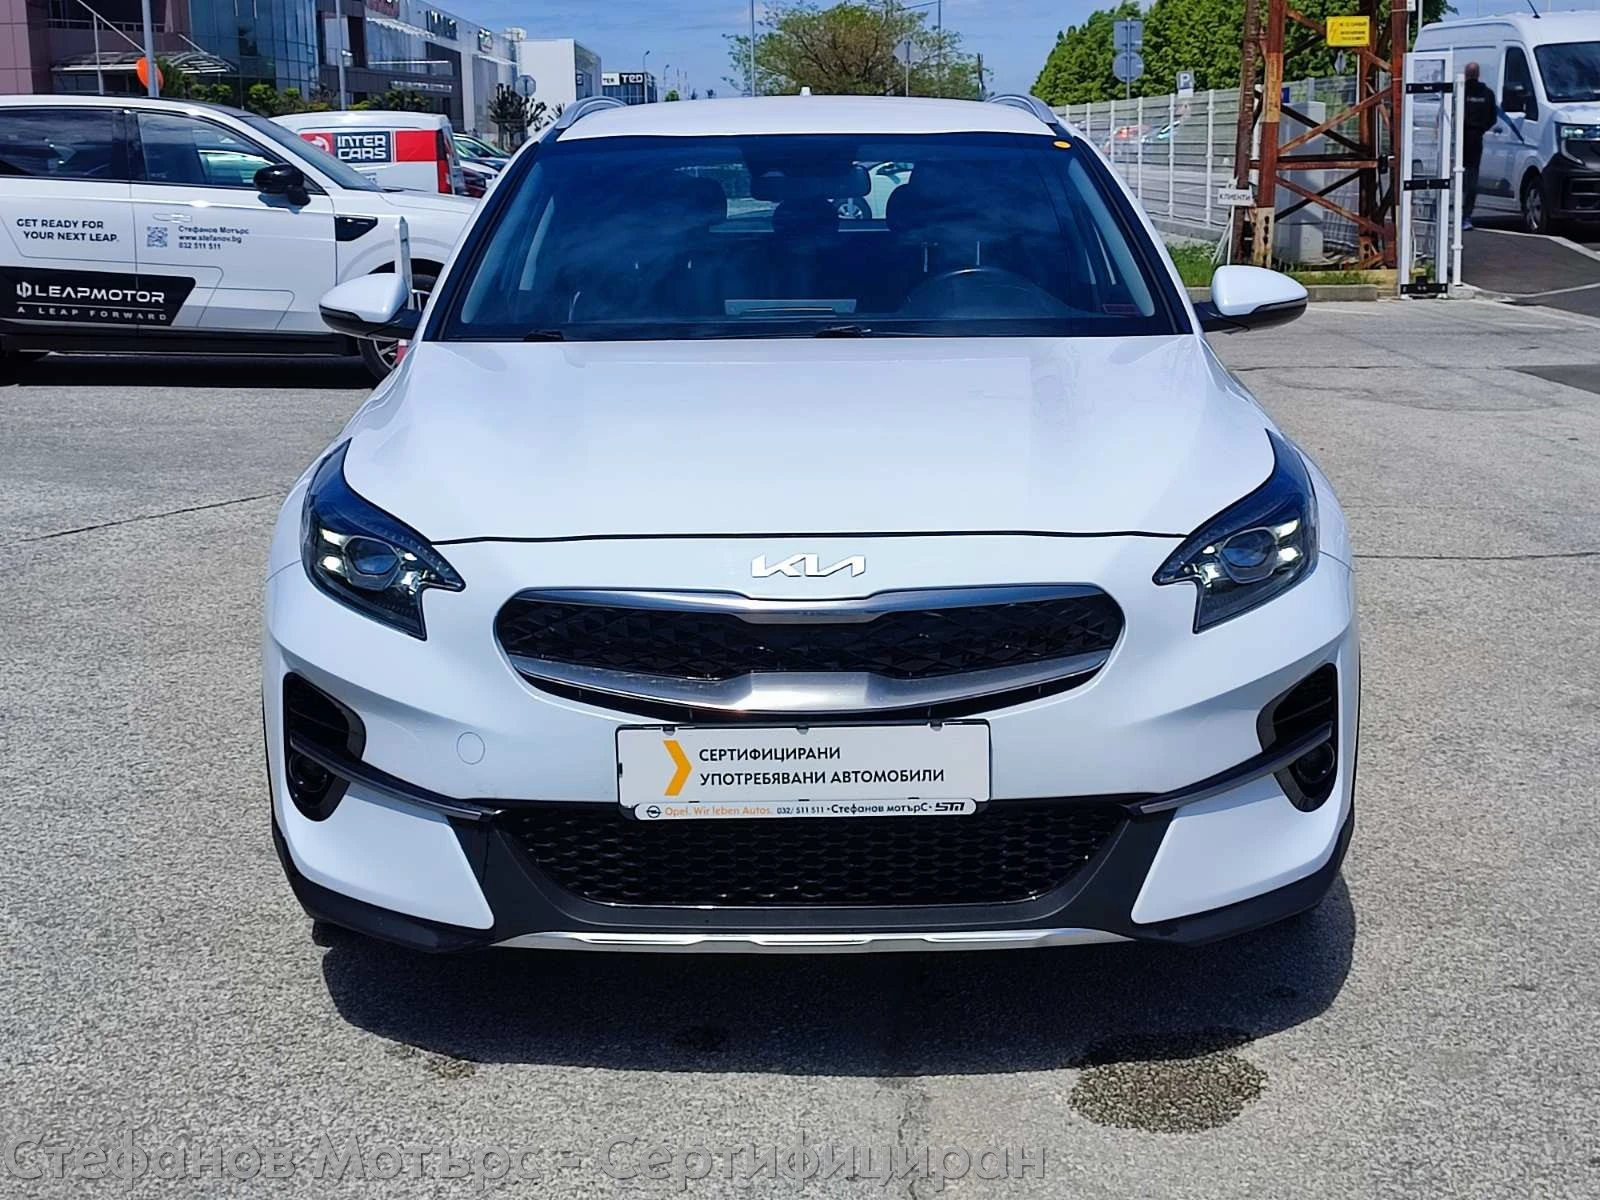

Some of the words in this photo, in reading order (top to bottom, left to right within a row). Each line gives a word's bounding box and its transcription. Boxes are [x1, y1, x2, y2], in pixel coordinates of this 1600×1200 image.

[337, 135, 386, 148] INTER
[338, 147, 386, 160] CARS
[16, 218, 37, 228] GET
[41, 218, 78, 229] READY
[82, 219, 104, 230] FOR
[178, 224, 218, 235] Стефанов
[219, 226, 250, 236] Мотърс
[23, 230, 54, 240] YOUR
[57, 231, 88, 242] NEXT
[89, 232, 119, 243] LEAP.
[178, 234, 242, 245] www.stefanov.bg
[178, 241, 194, 249] 032
[195, 242, 207, 250] 511
[35, 284, 165, 304] LEAPMOTOR
[38, 307, 79, 316] LEAP
[89, 309, 168, 321] FORWARD
[750, 553, 866, 578] KIA
[698, 746, 841, 762] СЕРТИФИЦИРАНИ
[699, 770, 827, 786] УПОТРЕБЯВАНИ
[830, 768, 945, 784] АВТОМОБИЛИ
[693, 806, 710, 815] Wir
[712, 805, 740, 815] leben
[795, 807, 809, 815] 511
[811, 806, 824, 814] 511
[831, 803, 884, 815] Стефанов
